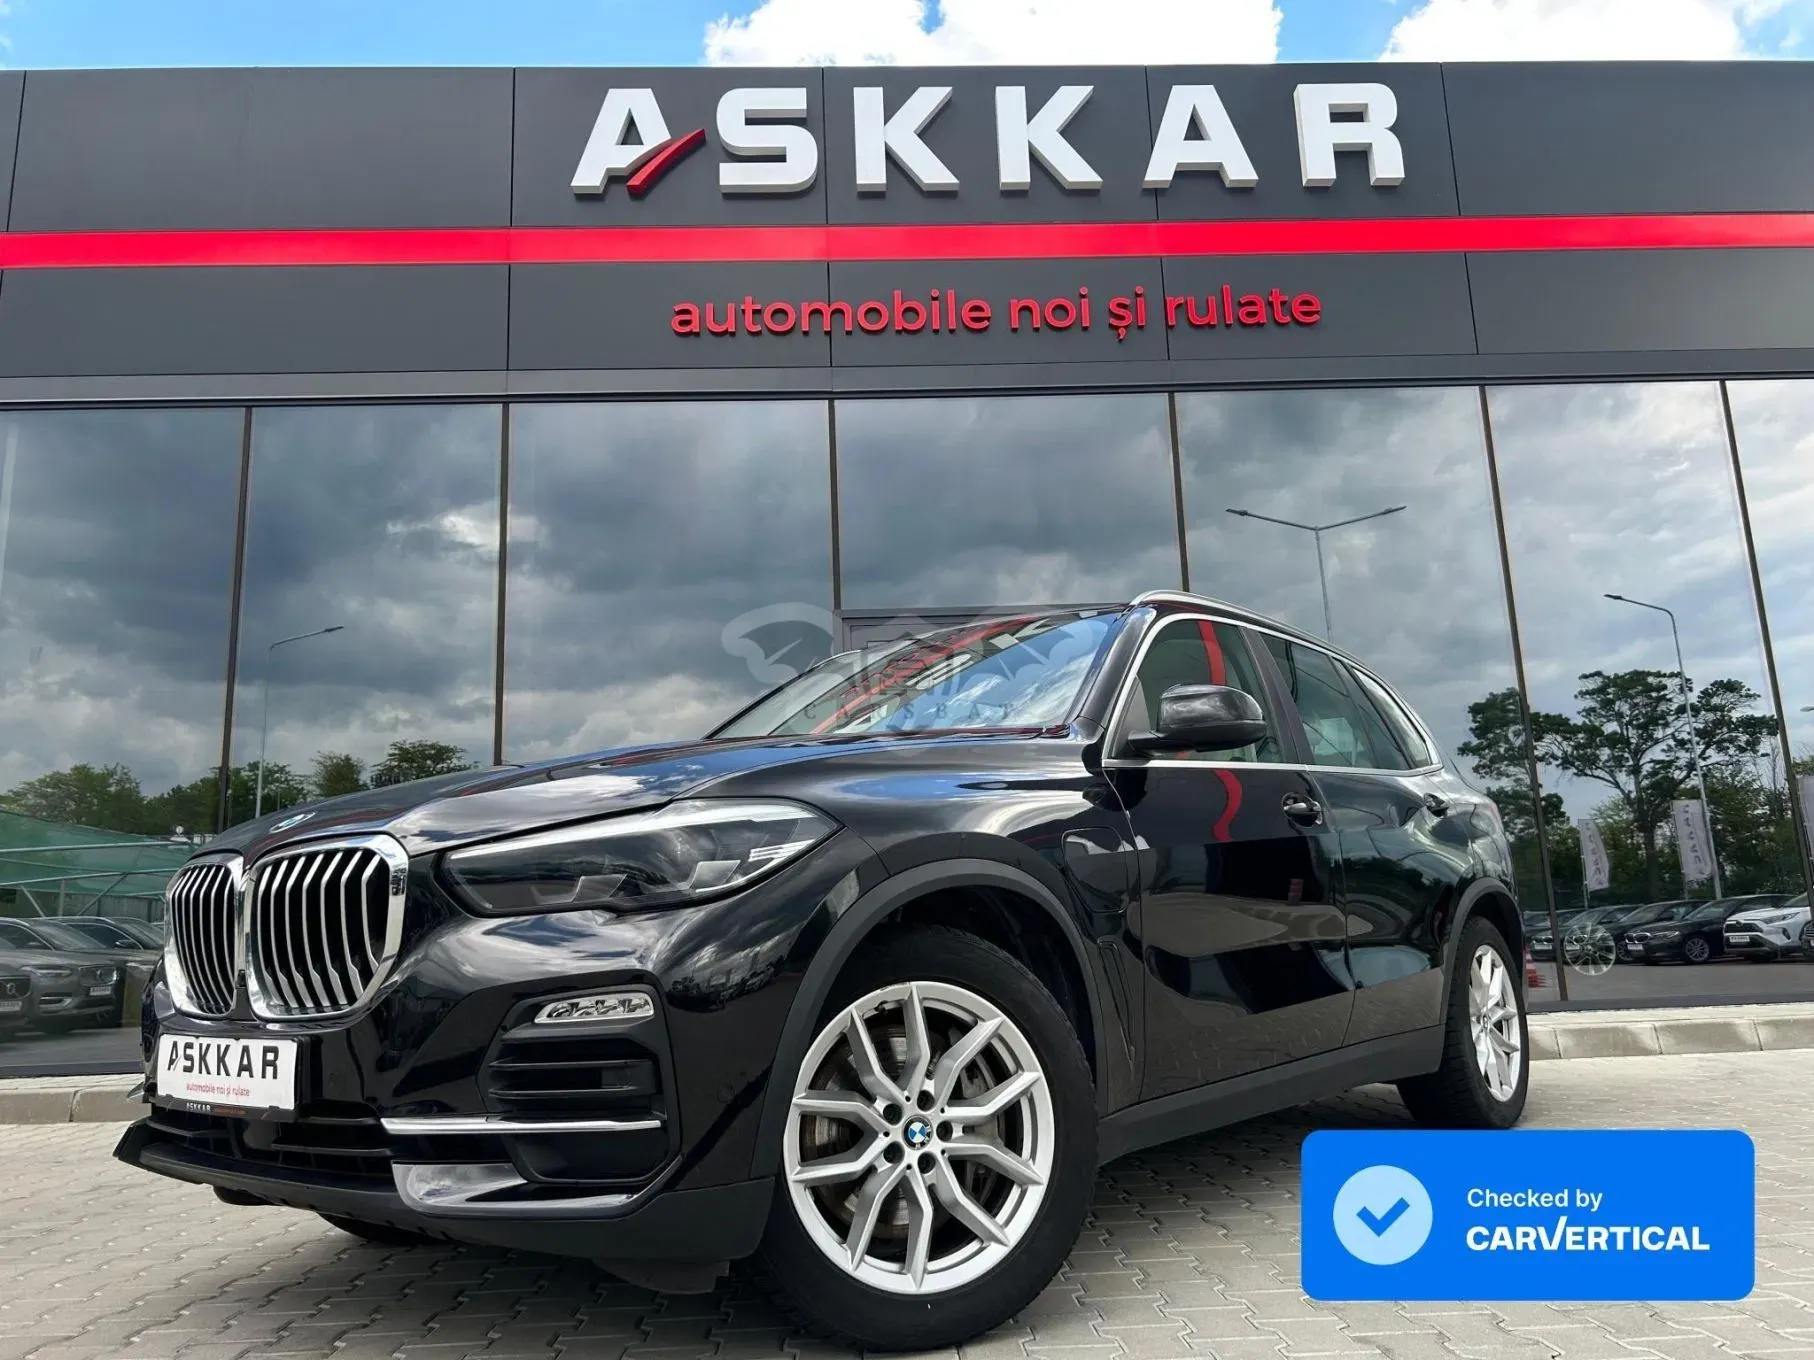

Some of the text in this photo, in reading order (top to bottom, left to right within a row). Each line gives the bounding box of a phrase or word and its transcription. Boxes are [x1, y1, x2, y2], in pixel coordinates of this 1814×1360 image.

[571, 82, 1405, 196] ASKKAR
[671, 284, 1322, 340] automobile noi și rulate
[167, 1040, 280, 1079] ASKKAR
[186, 1083, 215, 1094] automobile
